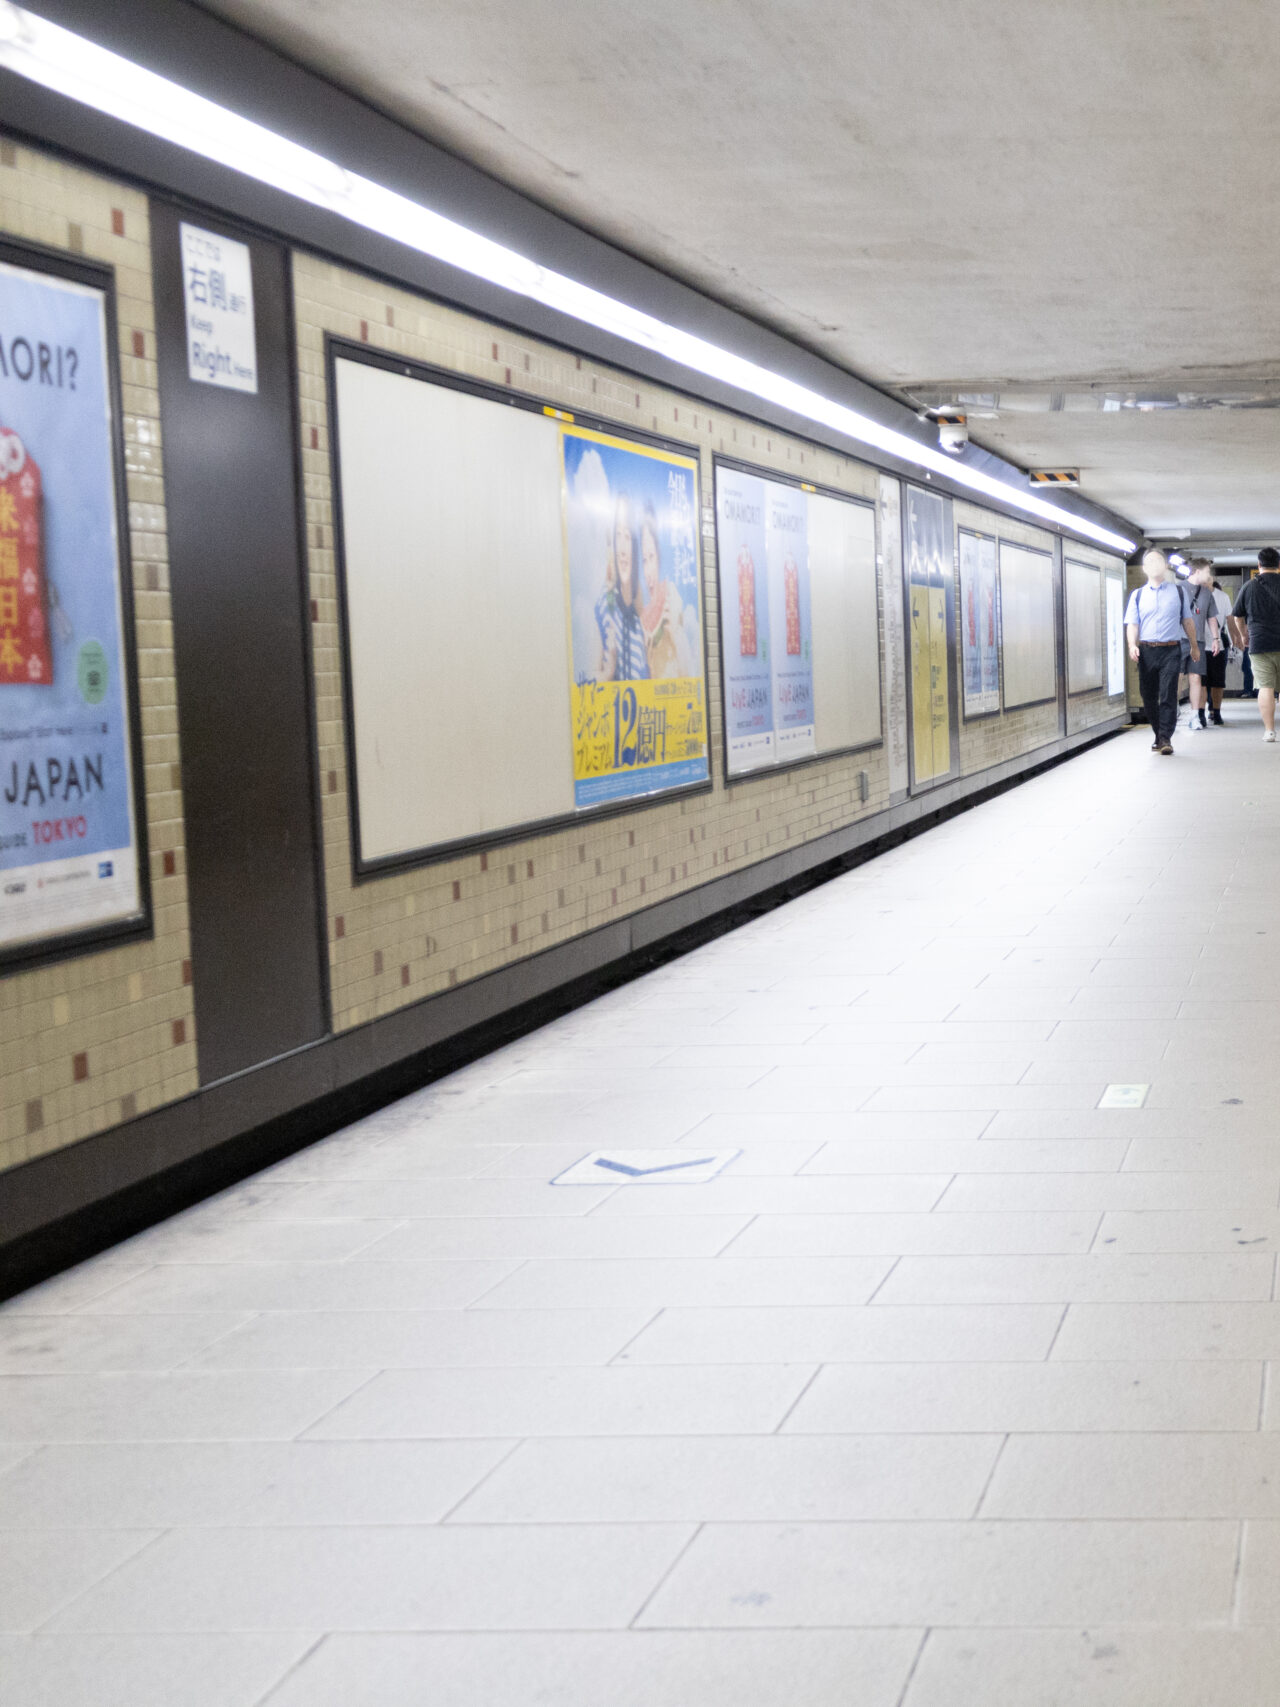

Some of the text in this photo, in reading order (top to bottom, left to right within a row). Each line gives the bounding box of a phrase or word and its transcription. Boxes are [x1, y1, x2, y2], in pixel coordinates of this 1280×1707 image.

[193, 341, 232, 379] Right
[612, 686, 666, 768] 12億円
[6, 755, 104, 806] JAPAN
[32, 814, 88, 845] TOKYO
